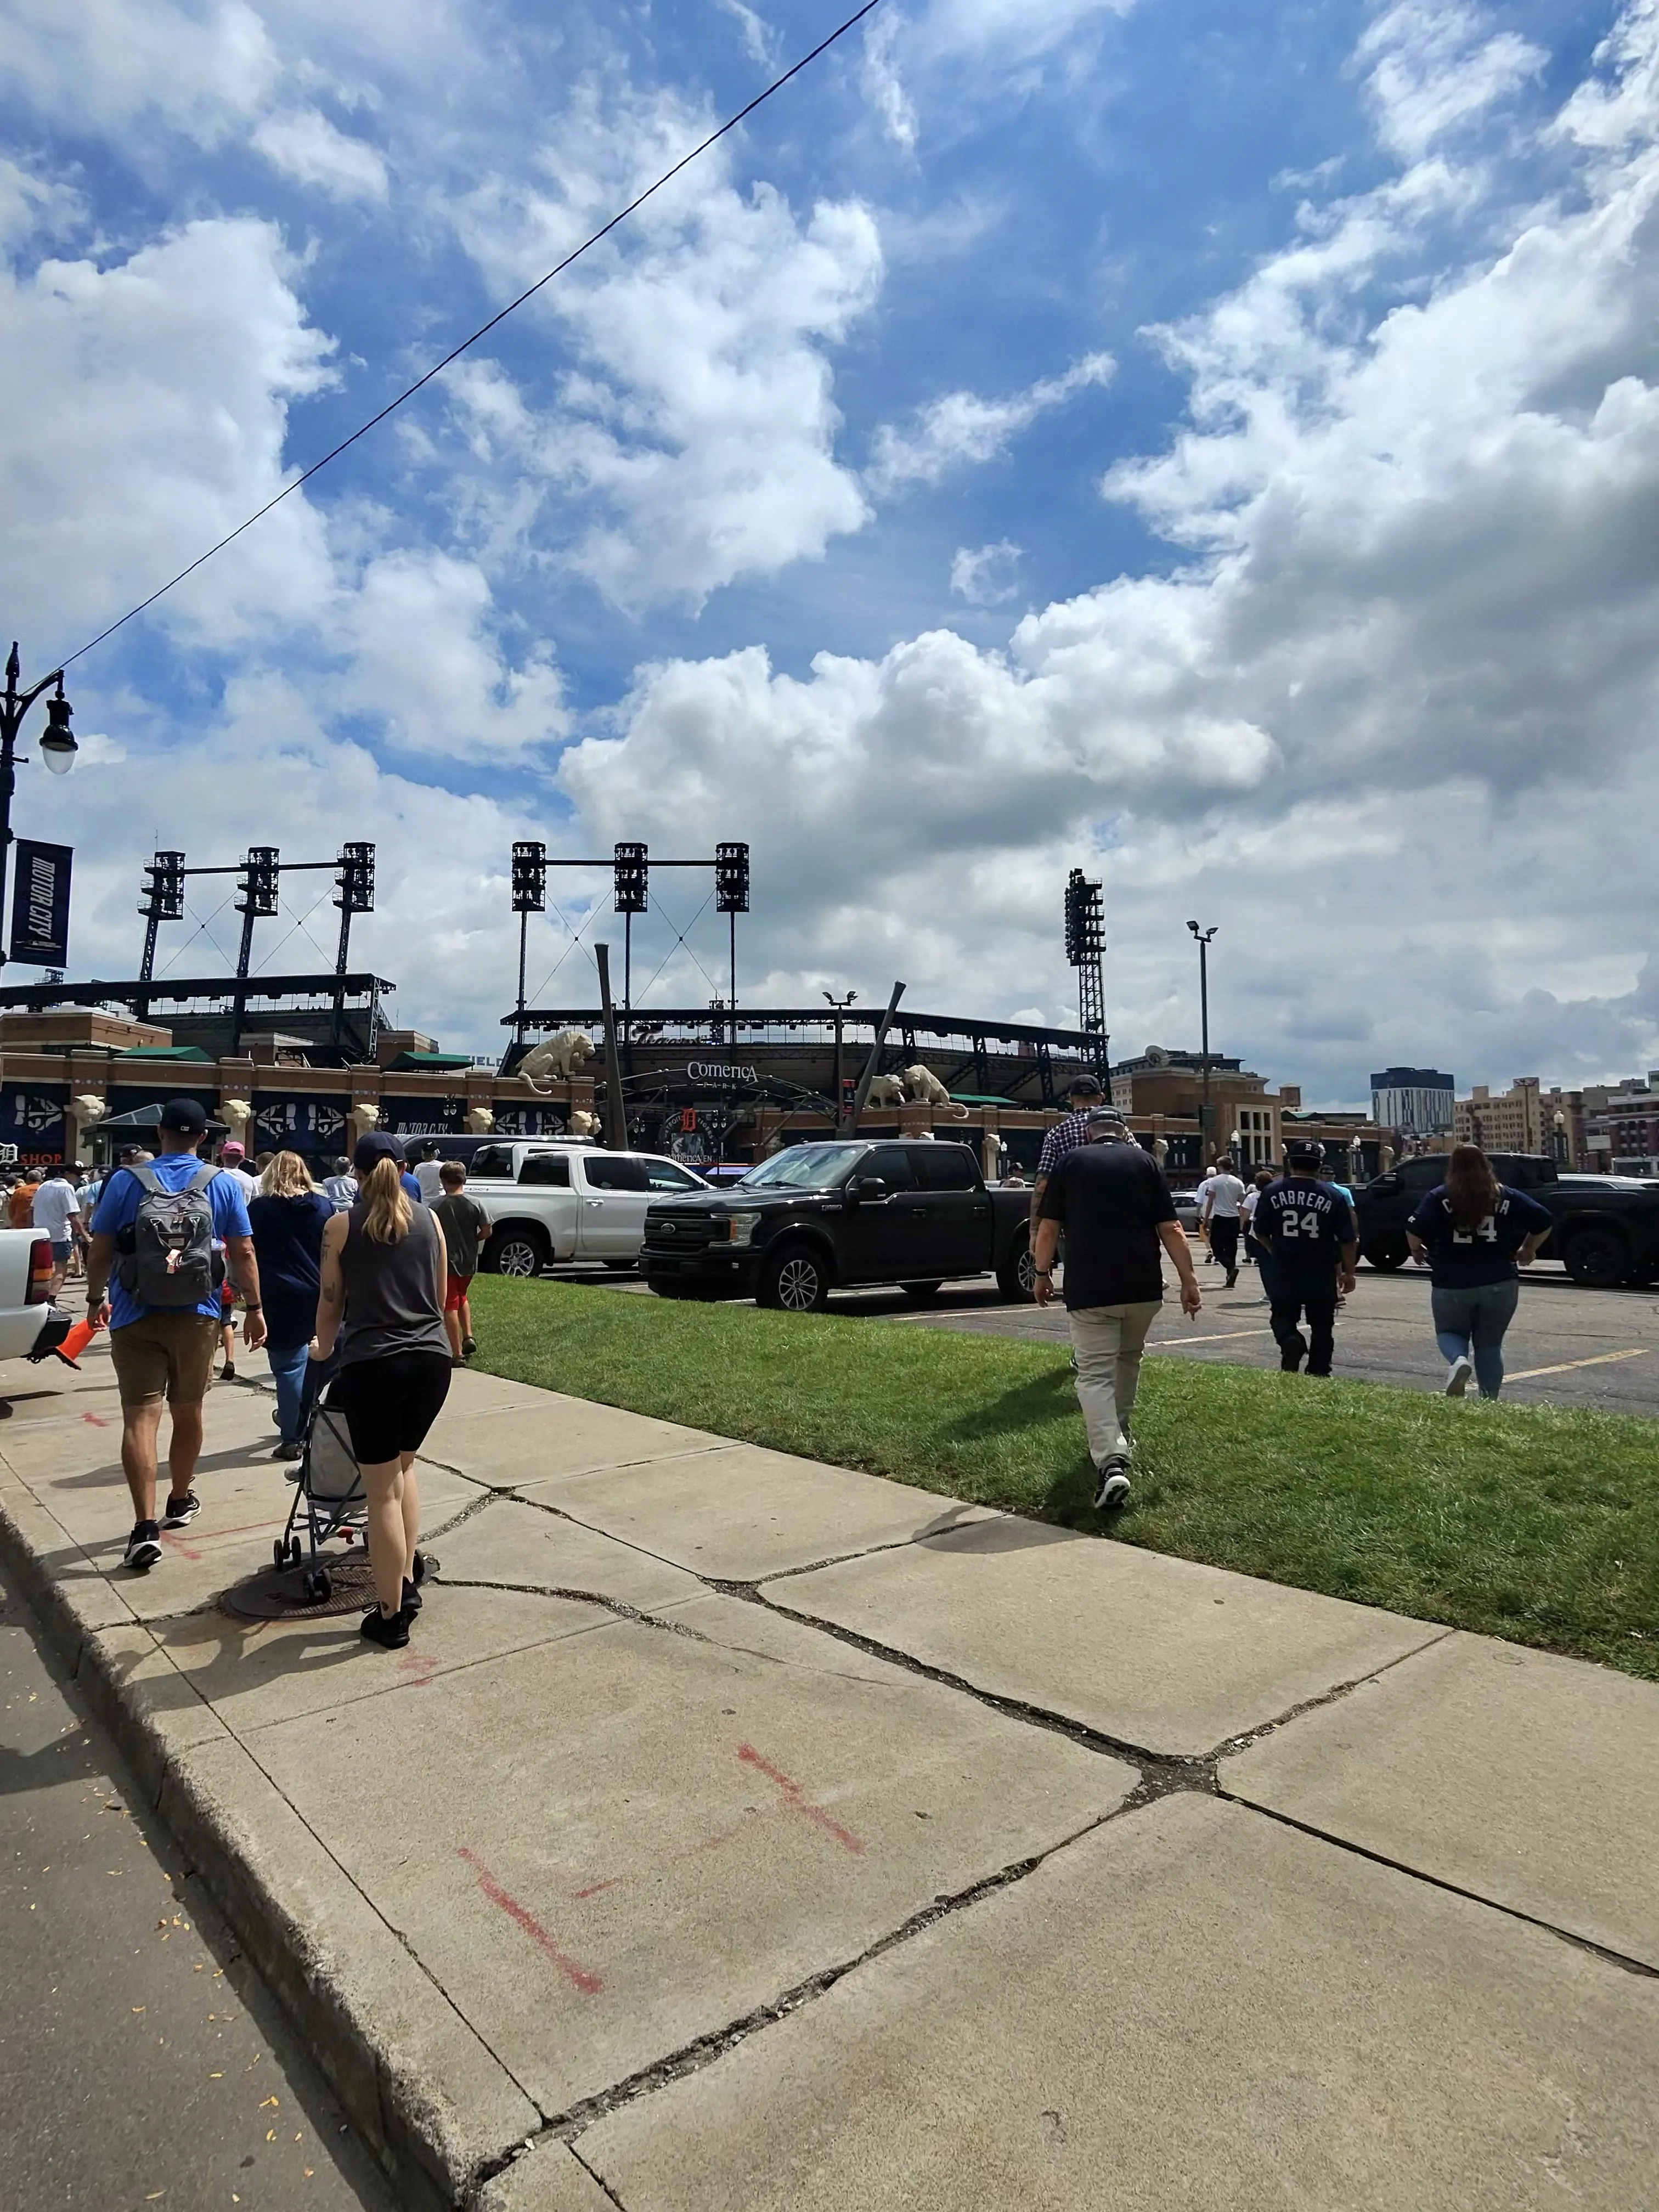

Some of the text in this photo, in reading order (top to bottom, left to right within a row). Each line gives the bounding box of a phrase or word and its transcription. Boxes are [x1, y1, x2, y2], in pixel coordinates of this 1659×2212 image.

[30, 856, 55, 906] MOTOR
[29, 905, 53, 939] CITY
[467, 1056, 504, 1066] IELD
[20, 1154, 62, 1164] SHOP
[1270, 1190, 1332, 1214] CABRERA
[1282, 1210, 1319, 1238] 24
